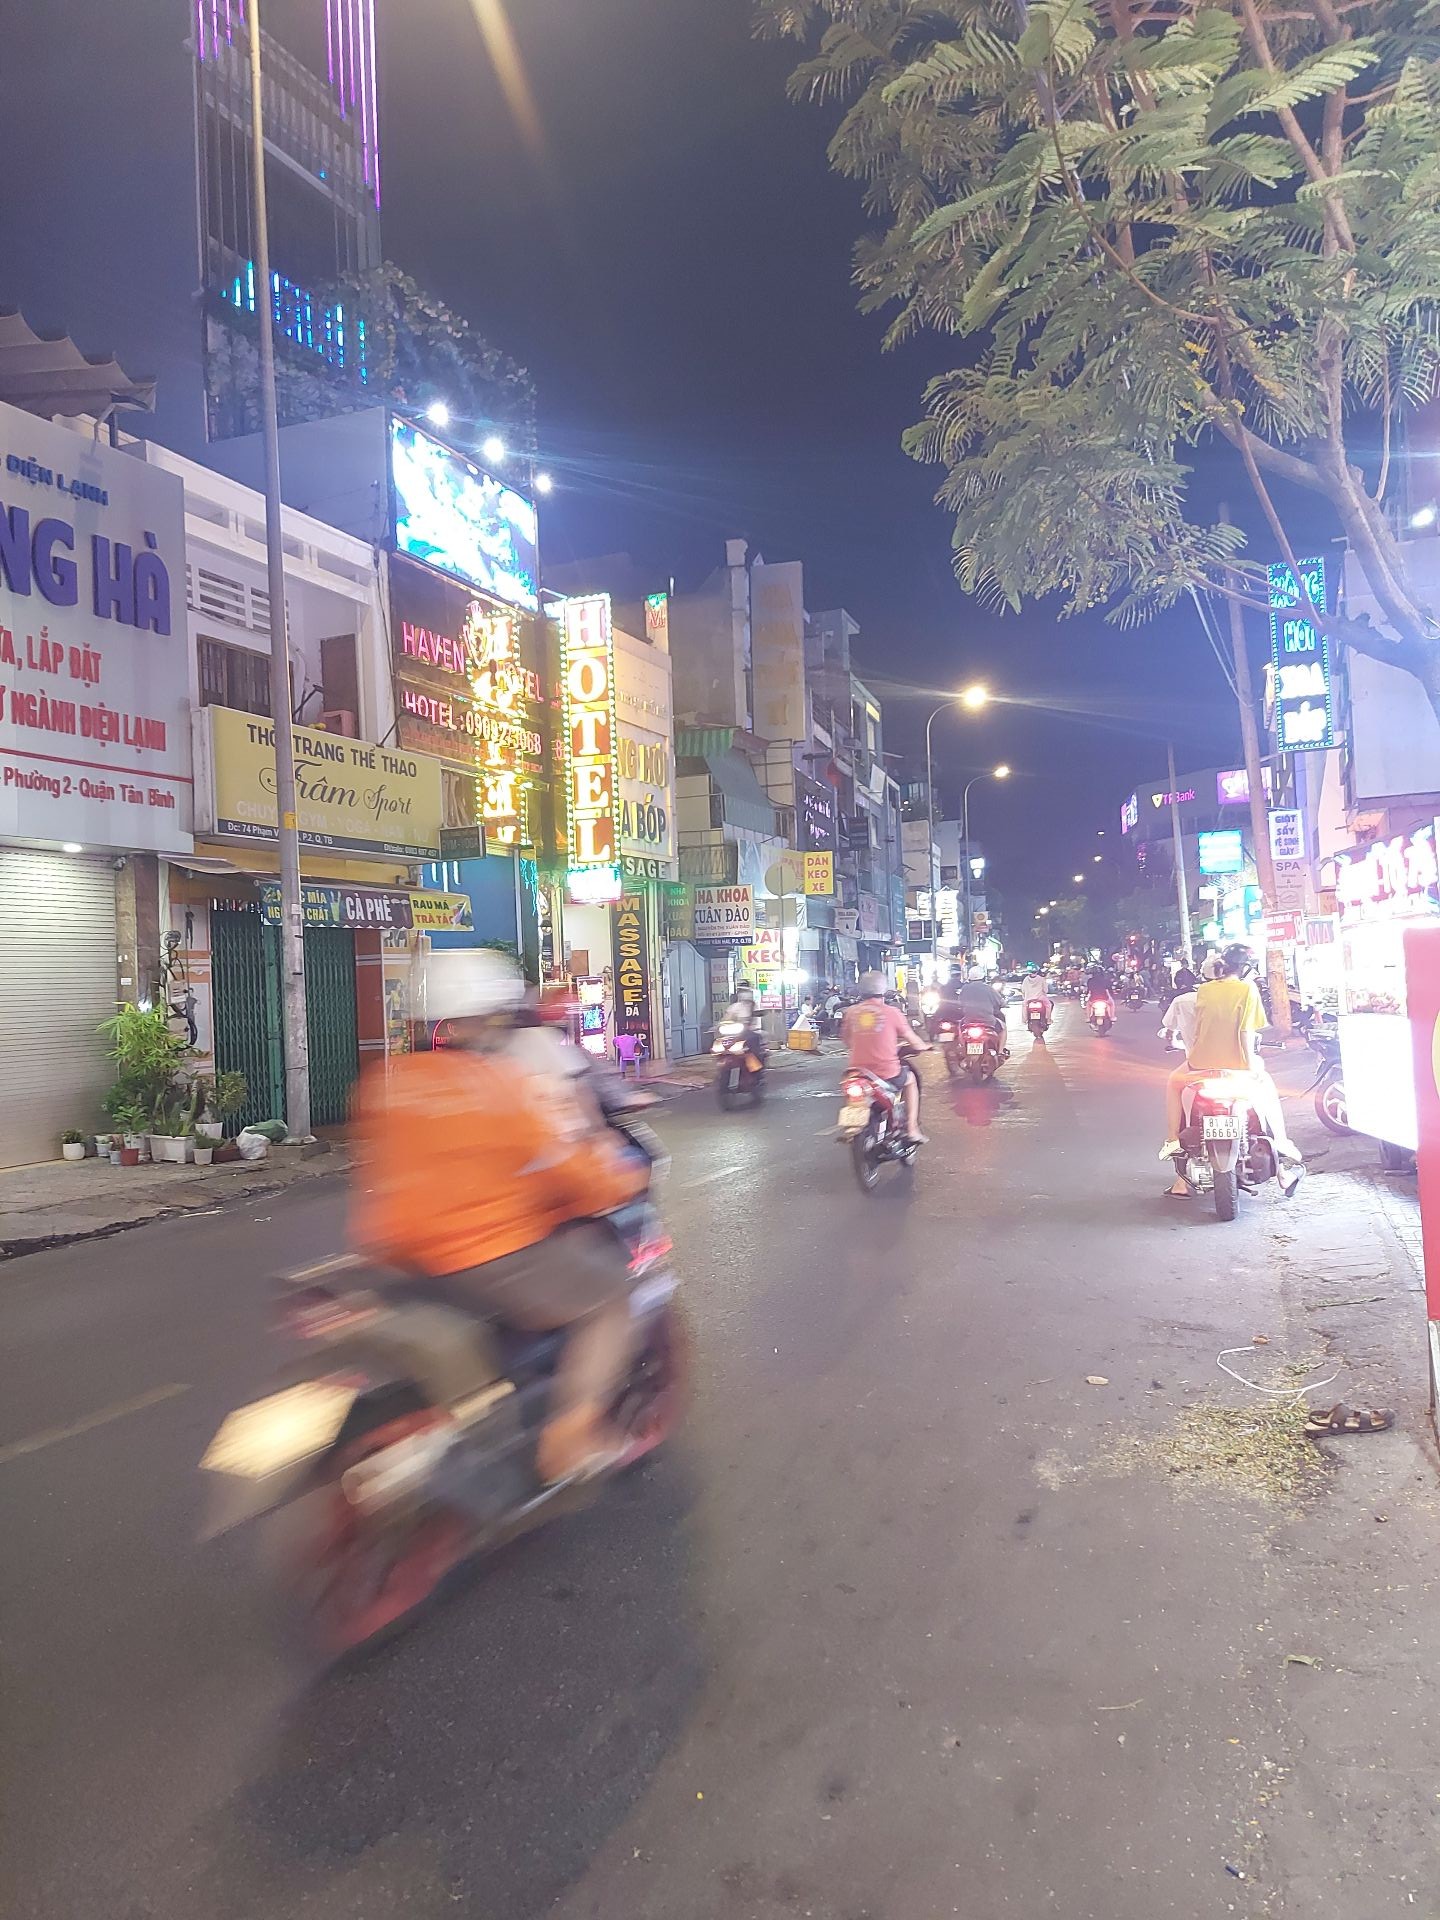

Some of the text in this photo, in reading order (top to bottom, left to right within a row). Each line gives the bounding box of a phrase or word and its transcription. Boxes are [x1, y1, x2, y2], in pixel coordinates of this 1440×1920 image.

[92, 531, 171, 637] HÀ
[402, 621, 465, 674] HAVEN
[11, 688, 76, 735] NGÀNH
[567, 603, 612, 863] HOTEL
[293, 733, 345, 763] TRANG
[381, 756, 417, 778] THAO
[4, 766, 61, 799] Phường
[119, 783, 144, 804] Tân
[363, 785, 413, 821] Sport
[242, 824, 251, 833] 74
[252, 826, 272, 837] Phạm
[807, 869, 829, 879] KEO
[1276, 861, 1300, 871] SPA
[717, 887, 750, 903] KHOA
[812, 882, 825, 891] XE
[345, 892, 393, 922] CÀ PHÊ
[413, 899, 433, 910] RAU
[725, 904, 750, 922] ĐÀO
[415, 914, 434, 924] TRÀ
[615, 897, 643, 1002] MASSAGE
[625, 1003, 640, 1017] ĐÁ
